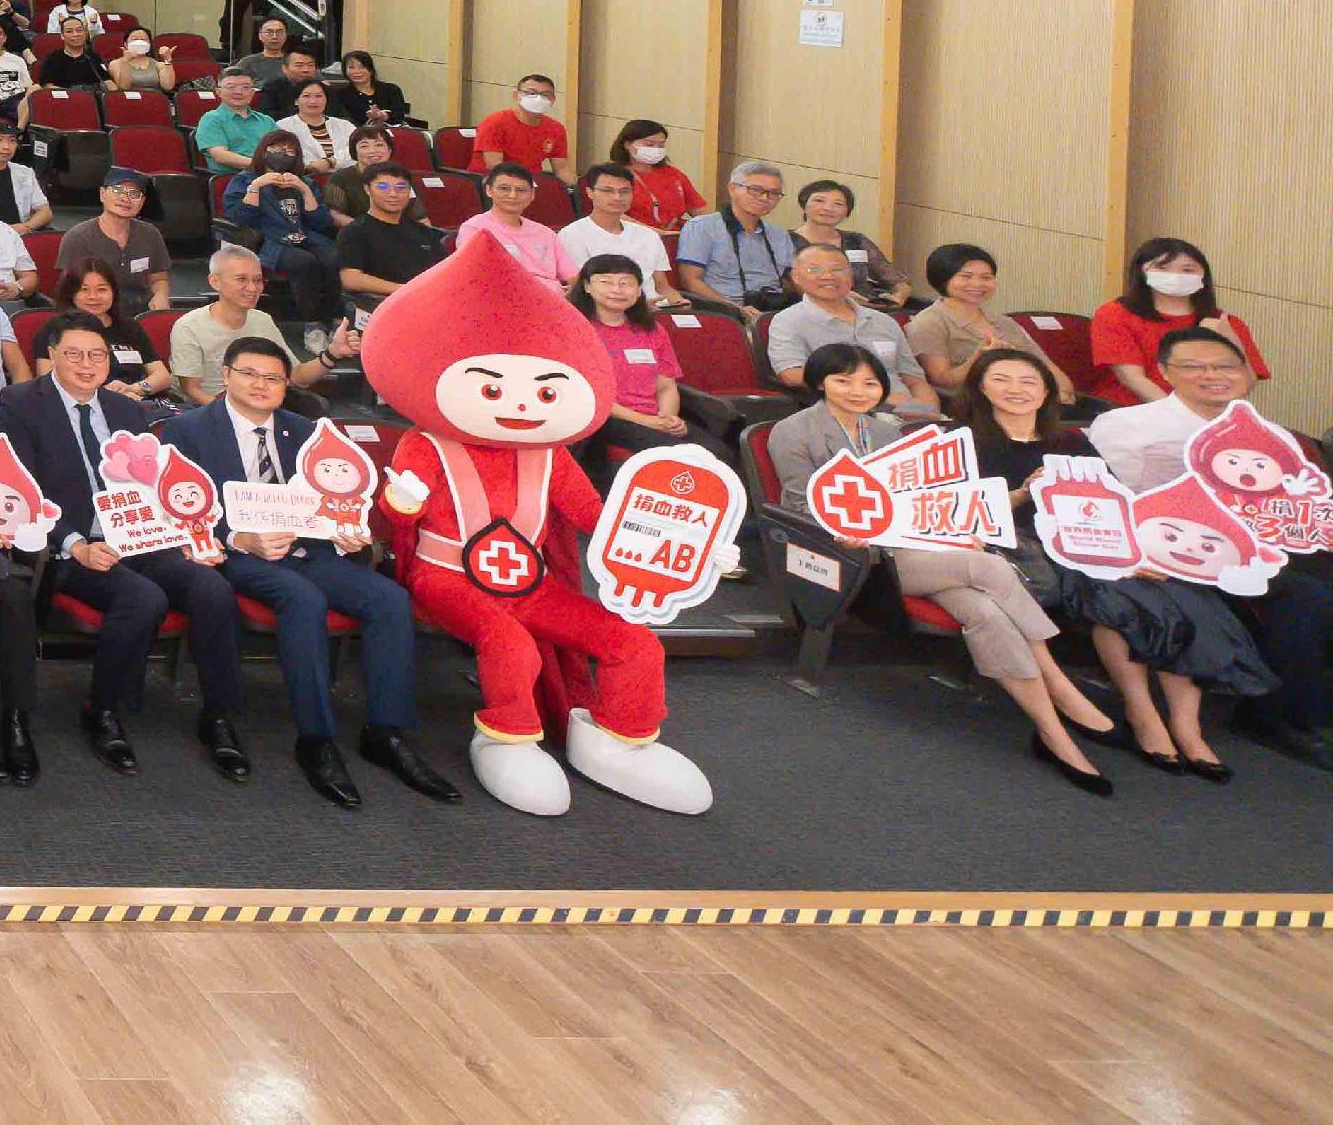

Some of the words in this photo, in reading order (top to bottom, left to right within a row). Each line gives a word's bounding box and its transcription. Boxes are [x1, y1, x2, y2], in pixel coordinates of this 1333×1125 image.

[888, 439, 968, 492] 捐血
[96, 490, 141, 511] 愛捐血
[110, 506, 155, 528] 分享愛
[633, 494, 708, 527] 捐血救人
[911, 490, 1001, 537] 救人
[119, 543, 133, 552] We
[135, 539, 163, 549] share
[649, 539, 696, 572] AB
